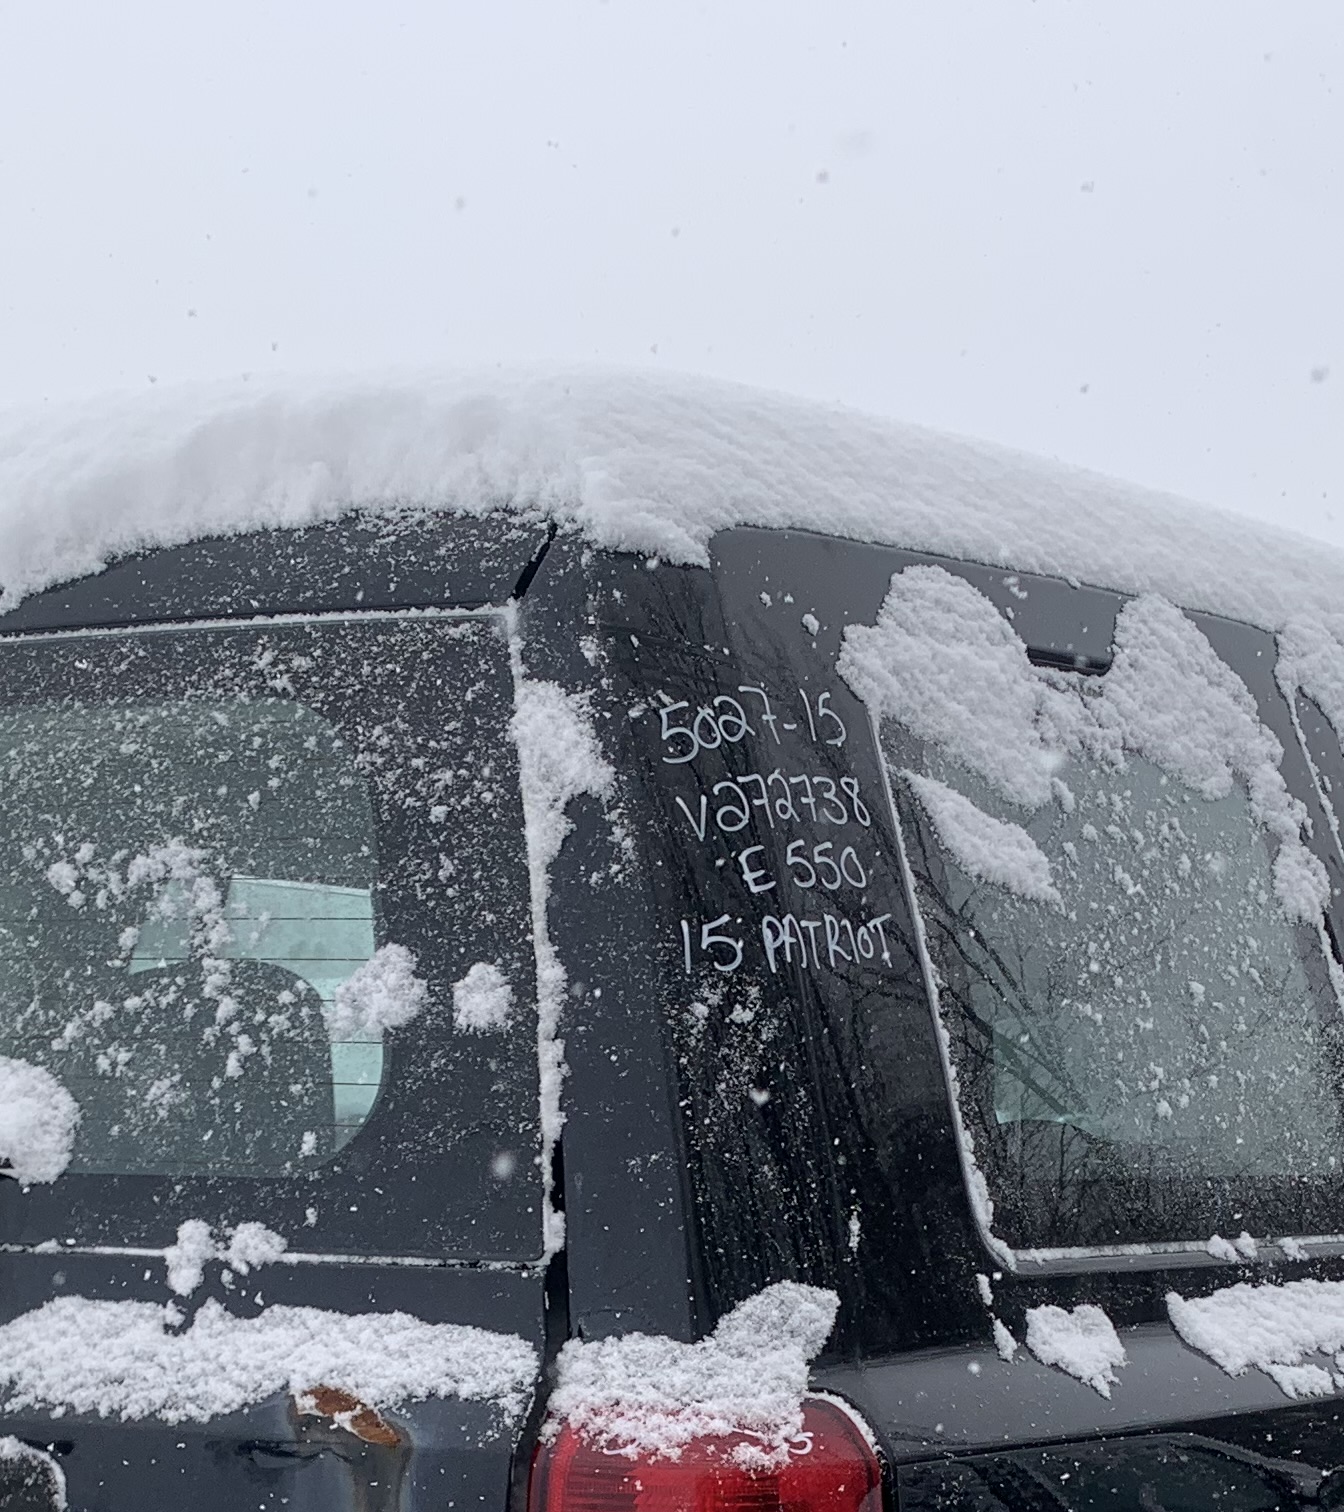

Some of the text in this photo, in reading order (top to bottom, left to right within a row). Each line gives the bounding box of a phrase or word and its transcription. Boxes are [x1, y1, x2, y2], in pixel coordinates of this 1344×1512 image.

[660, 686, 847, 764] 5027-15
[675, 773, 870, 841] V272738
[739, 840, 867, 893] E 550
[680, 913, 892, 973] 15 PATRIOT
